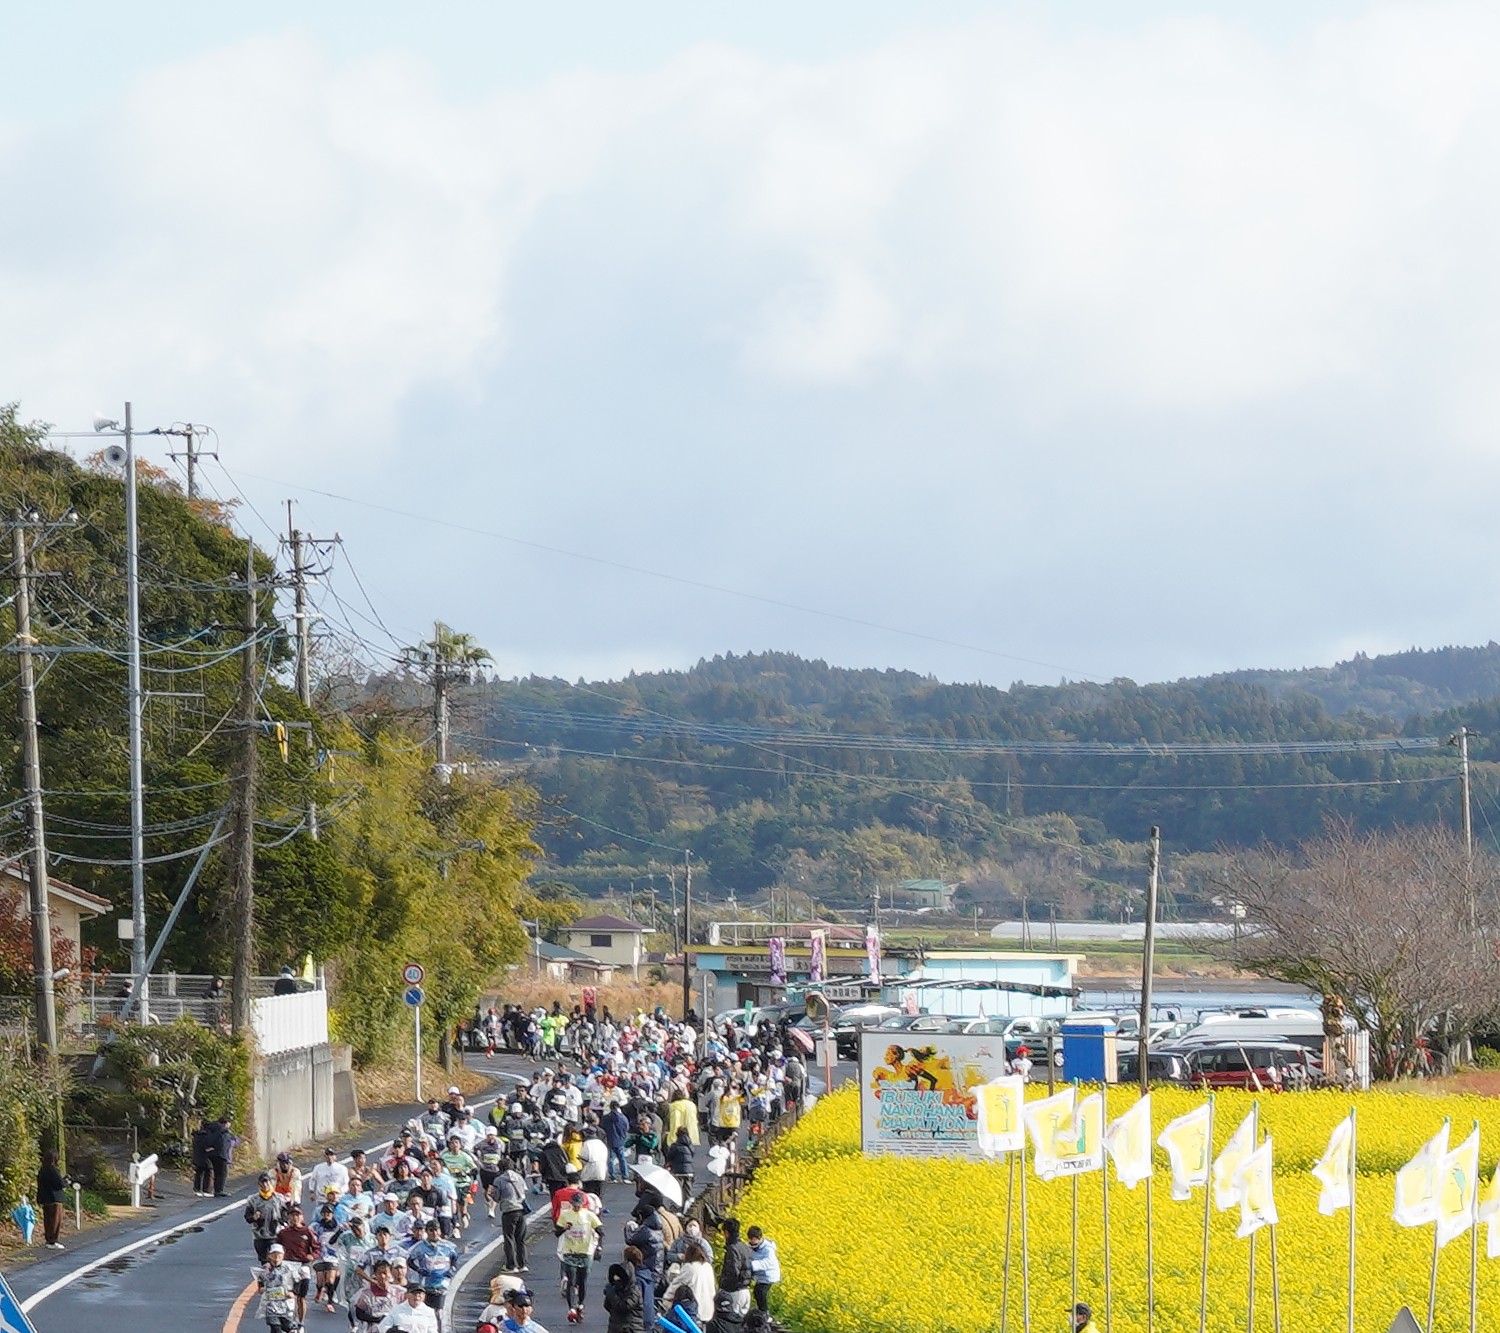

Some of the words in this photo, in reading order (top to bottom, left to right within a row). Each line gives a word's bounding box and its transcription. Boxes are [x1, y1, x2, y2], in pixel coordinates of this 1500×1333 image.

[880, 1091, 942, 1105] IBUSUKI
[879, 1104, 964, 1118] NANOHANA
[879, 1117, 967, 1131] MARATHON
